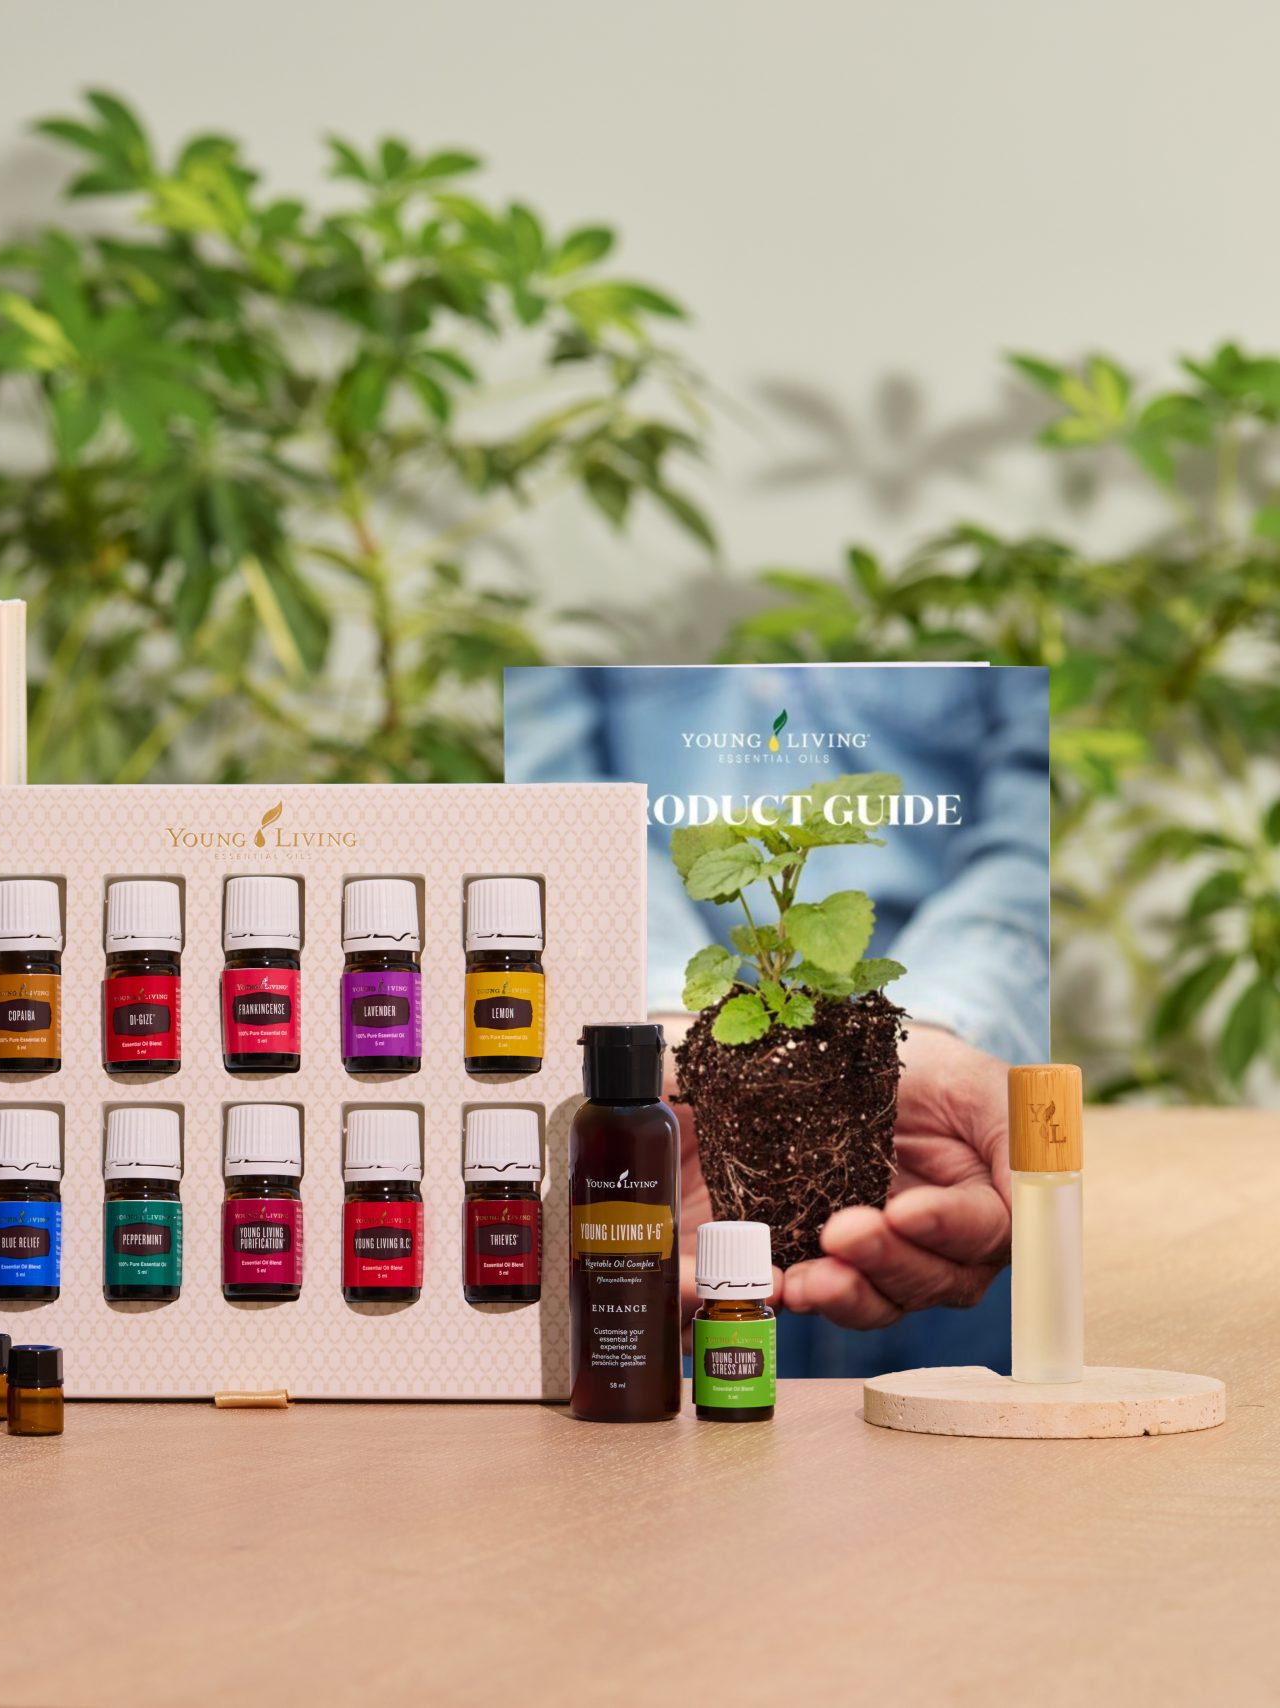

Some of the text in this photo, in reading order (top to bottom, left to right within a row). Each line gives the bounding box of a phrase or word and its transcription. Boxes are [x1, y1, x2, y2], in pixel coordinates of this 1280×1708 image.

[681, 733, 870, 749] YOUNG LIVING
[718, 754, 830, 764] ESSENTIAL OILS
[647, 794, 963, 826] ODUCT GUIDE
[166, 828, 357, 848] YOUNG LIVING
[214, 853, 313, 861] ESSENTIAL OILS
[238, 1003, 285, 1015] FRANKINCENSE
[363, 1005, 396, 1017] LAVENDER
[491, 1007, 515, 1019] LEMON
[8, 1010, 36, 1021] COPAIBA
[585, 1178, 655, 1190] YOUNG LIVING
[239, 1227, 284, 1238] YOUNG LIVING
[580, 1223, 608, 1241] YOUNG
[611, 1223, 644, 1241] LIVING
[1, 1236, 40, 1248] BLUE RELIEF
[122, 1233, 163, 1245] PEPPERMINT
[240, 1237, 284, 1249] PURIFICATION
[354, 1238, 375, 1249] YOUNG
[376, 1238, 398, 1249] LIVING
[490, 1234, 517, 1246] THIEVES
[585, 1259, 655, 1270] Vegetable Oil Complex
[592, 1304, 648, 1313] ENHANCE
[593, 1327, 645, 1337] Customise your
[599, 1335, 638, 1343] essential oil
[711, 1351, 757, 1363] YOUNG LIVING
[712, 1363, 756, 1375] STRESS AWAY
